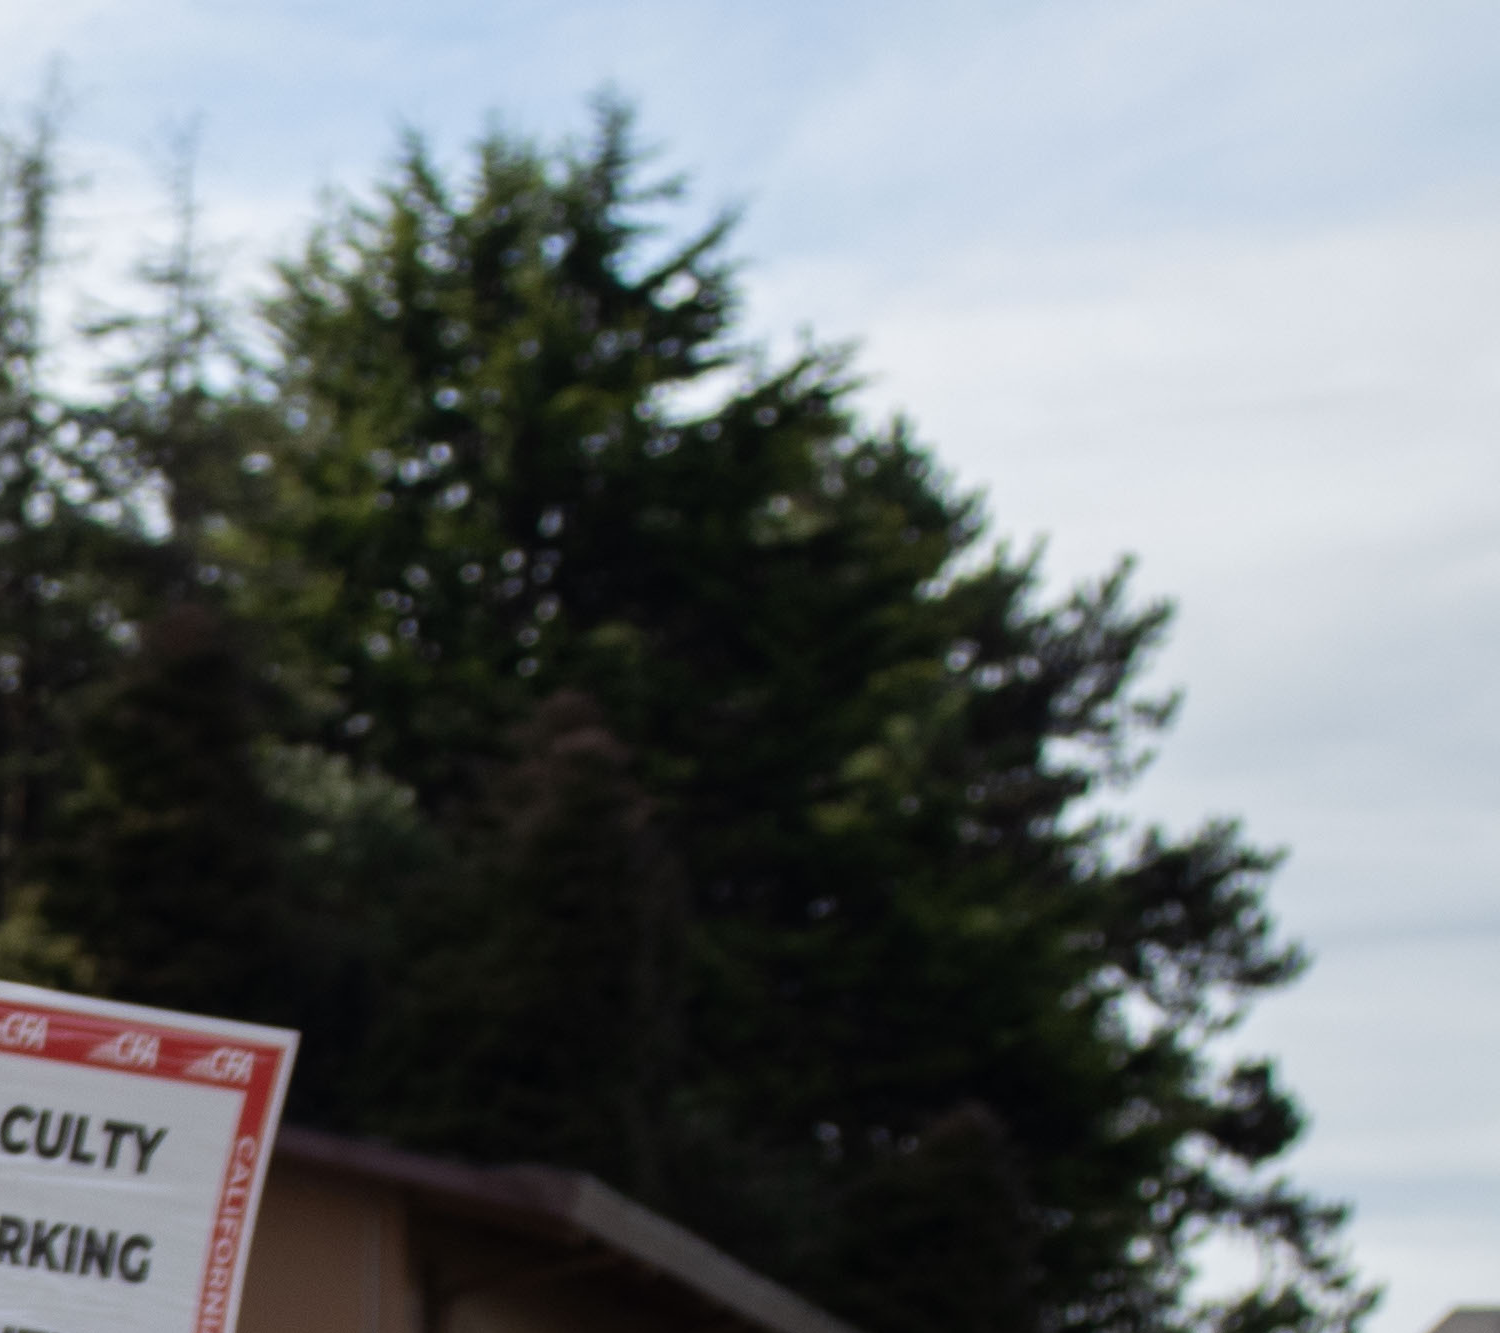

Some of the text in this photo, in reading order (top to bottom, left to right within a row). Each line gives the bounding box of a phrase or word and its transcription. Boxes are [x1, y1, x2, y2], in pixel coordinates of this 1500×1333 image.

[2, 1010, 49, 1050] CFA
[114, 1031, 161, 1070] CFA
[210, 1046, 257, 1084] CFA
